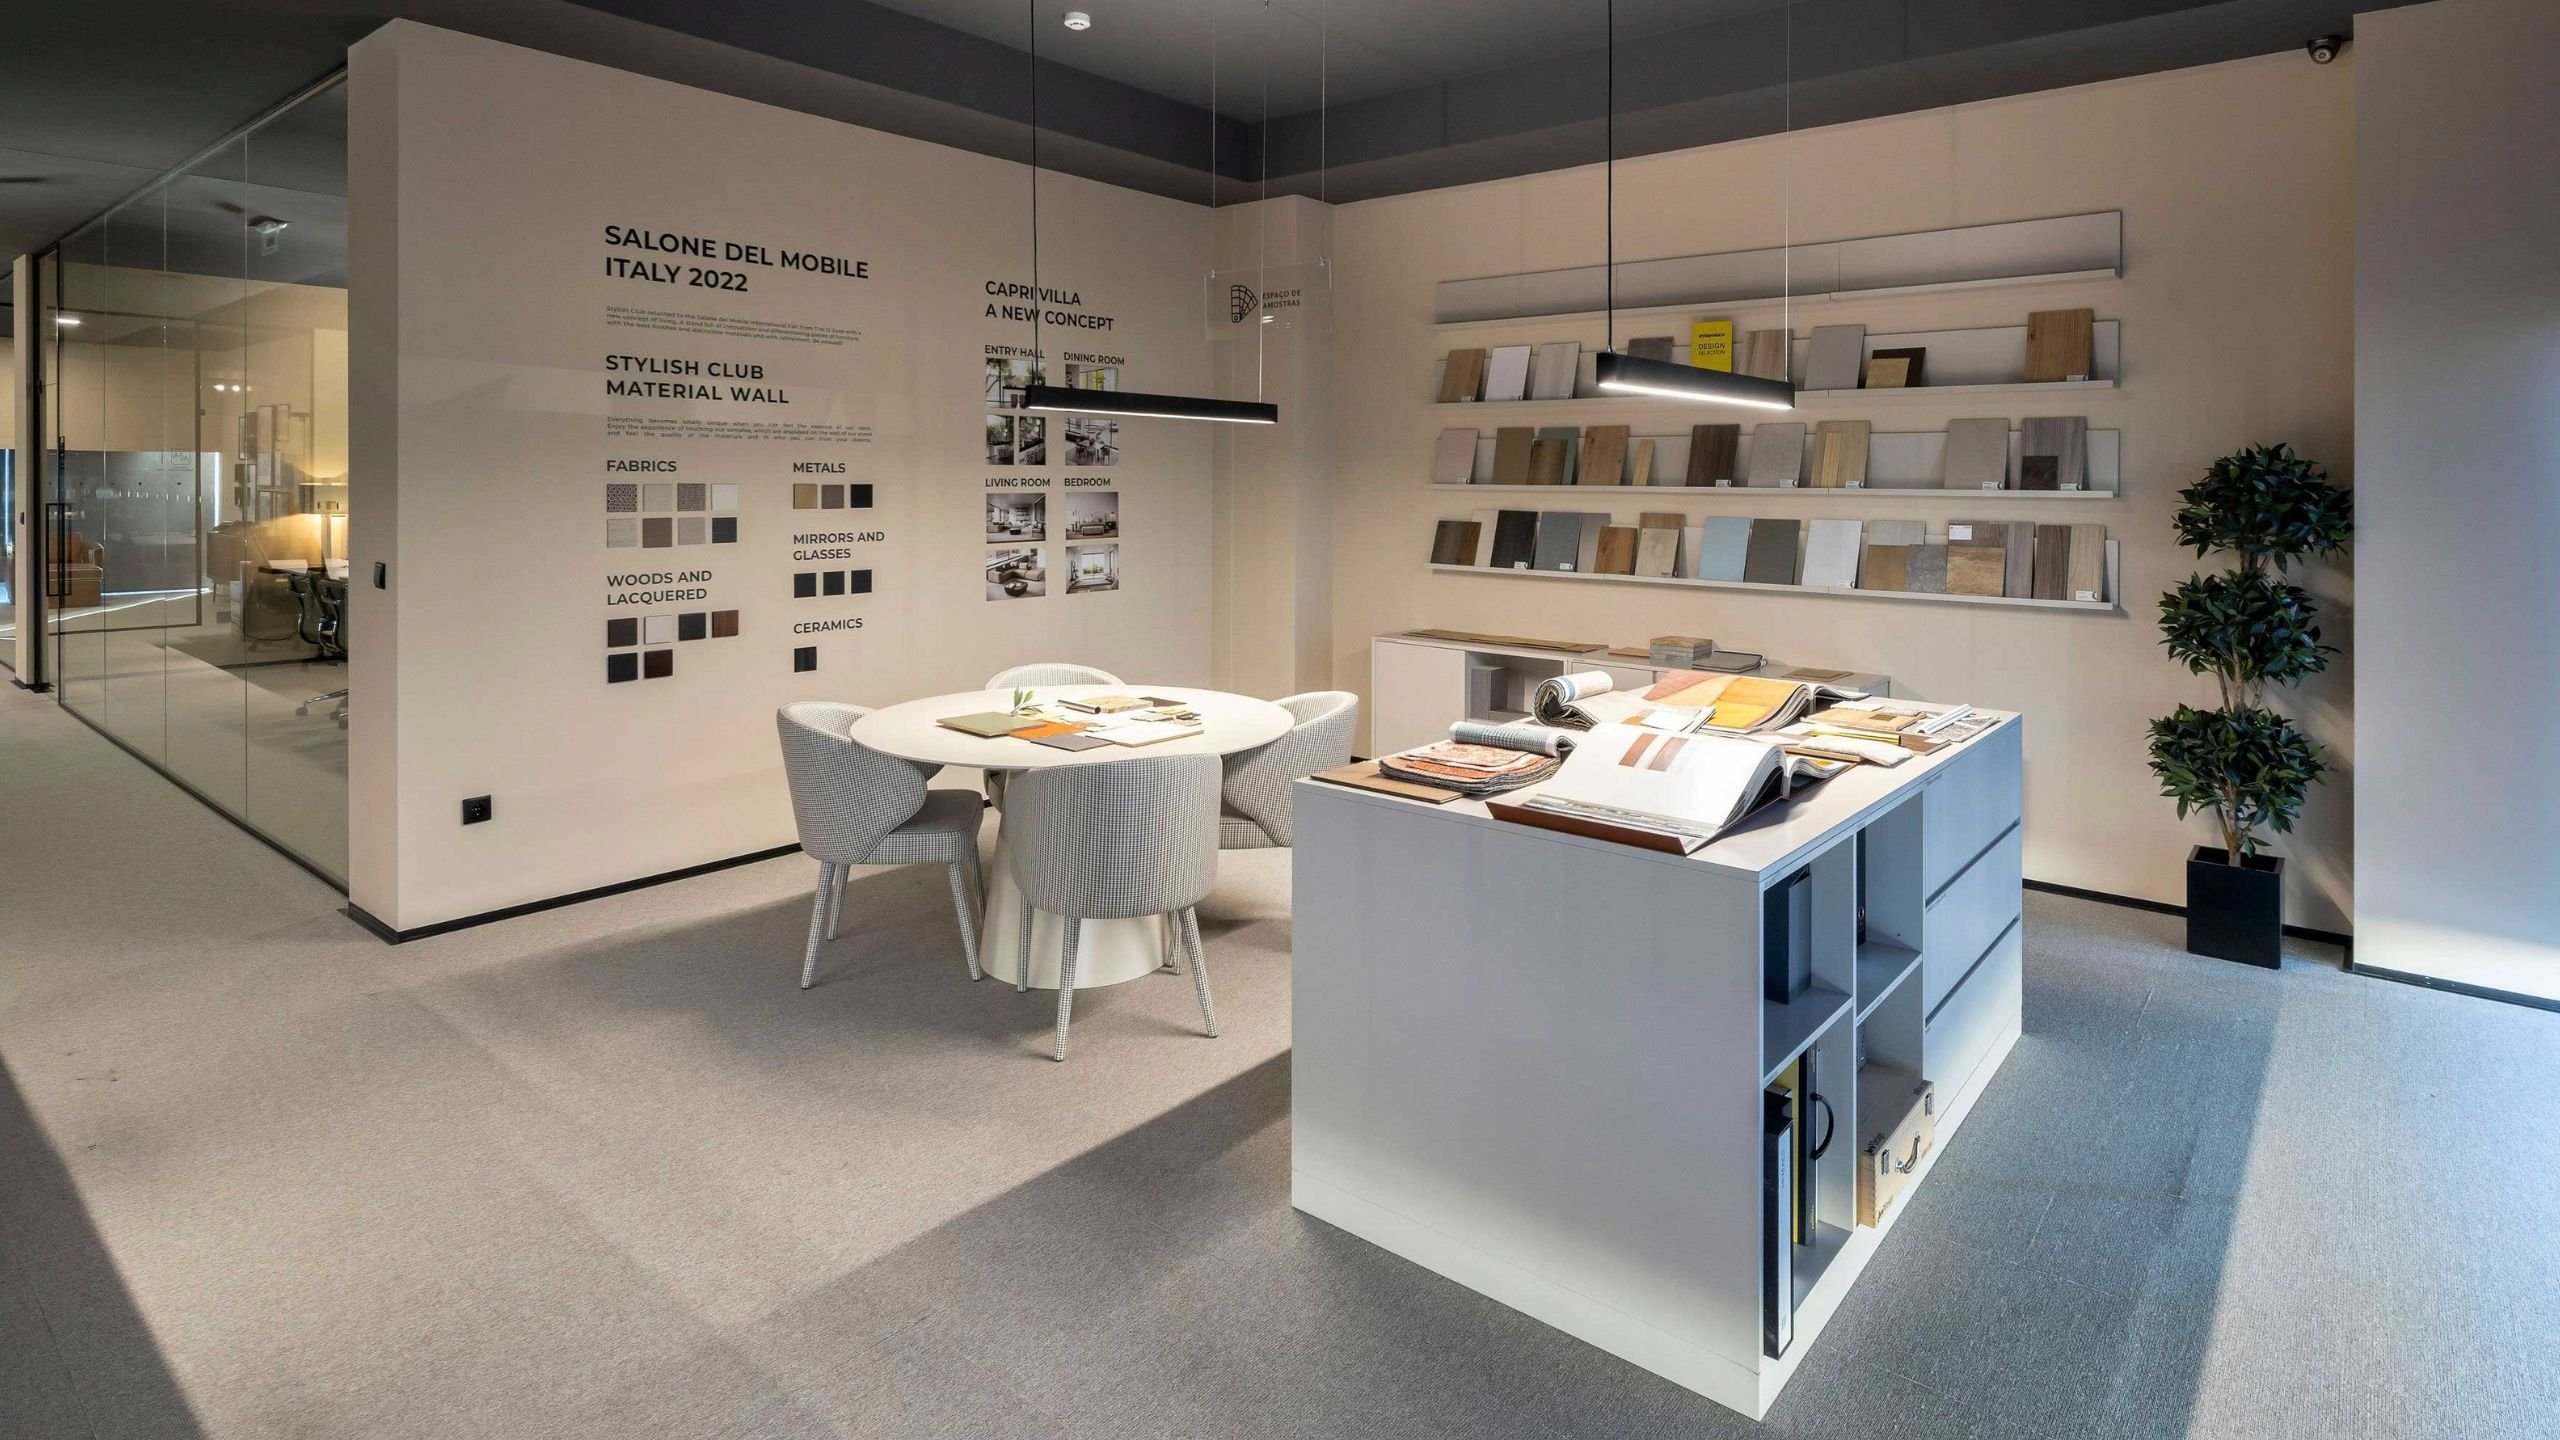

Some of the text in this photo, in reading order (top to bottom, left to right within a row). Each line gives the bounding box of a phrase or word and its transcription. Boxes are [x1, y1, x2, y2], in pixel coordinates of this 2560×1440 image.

[606, 226, 868, 278] SALONE DEL MOBILE
[607, 257, 747, 291] ITALY 2022
[986, 281, 1081, 305] CAPRI VILLA
[1263, 291, 1289, 299] ESPAÇO
[1263, 300, 1300, 308] AMOSTRAS
[985, 304, 1113, 330] A NEW CONCEPT
[985, 345, 1017, 355] ENTRY
[1064, 352, 1124, 365] DINING ROOM
[606, 355, 763, 379] STYLISH CLUB
[607, 380, 789, 403] MATERIAL WALL
[607, 460, 676, 472] FABRICS
[794, 463, 845, 473] METALS
[986, 479, 1017, 487] LIVING
[1065, 478, 1110, 486] BEDROOM
[794, 532, 884, 544] MIRRORS AND
[794, 549, 850, 560] GLASSES
[607, 571, 712, 586] WOODS AND
[608, 589, 707, 605] LACQUERED
[794, 618, 862, 633] CERAMICS
